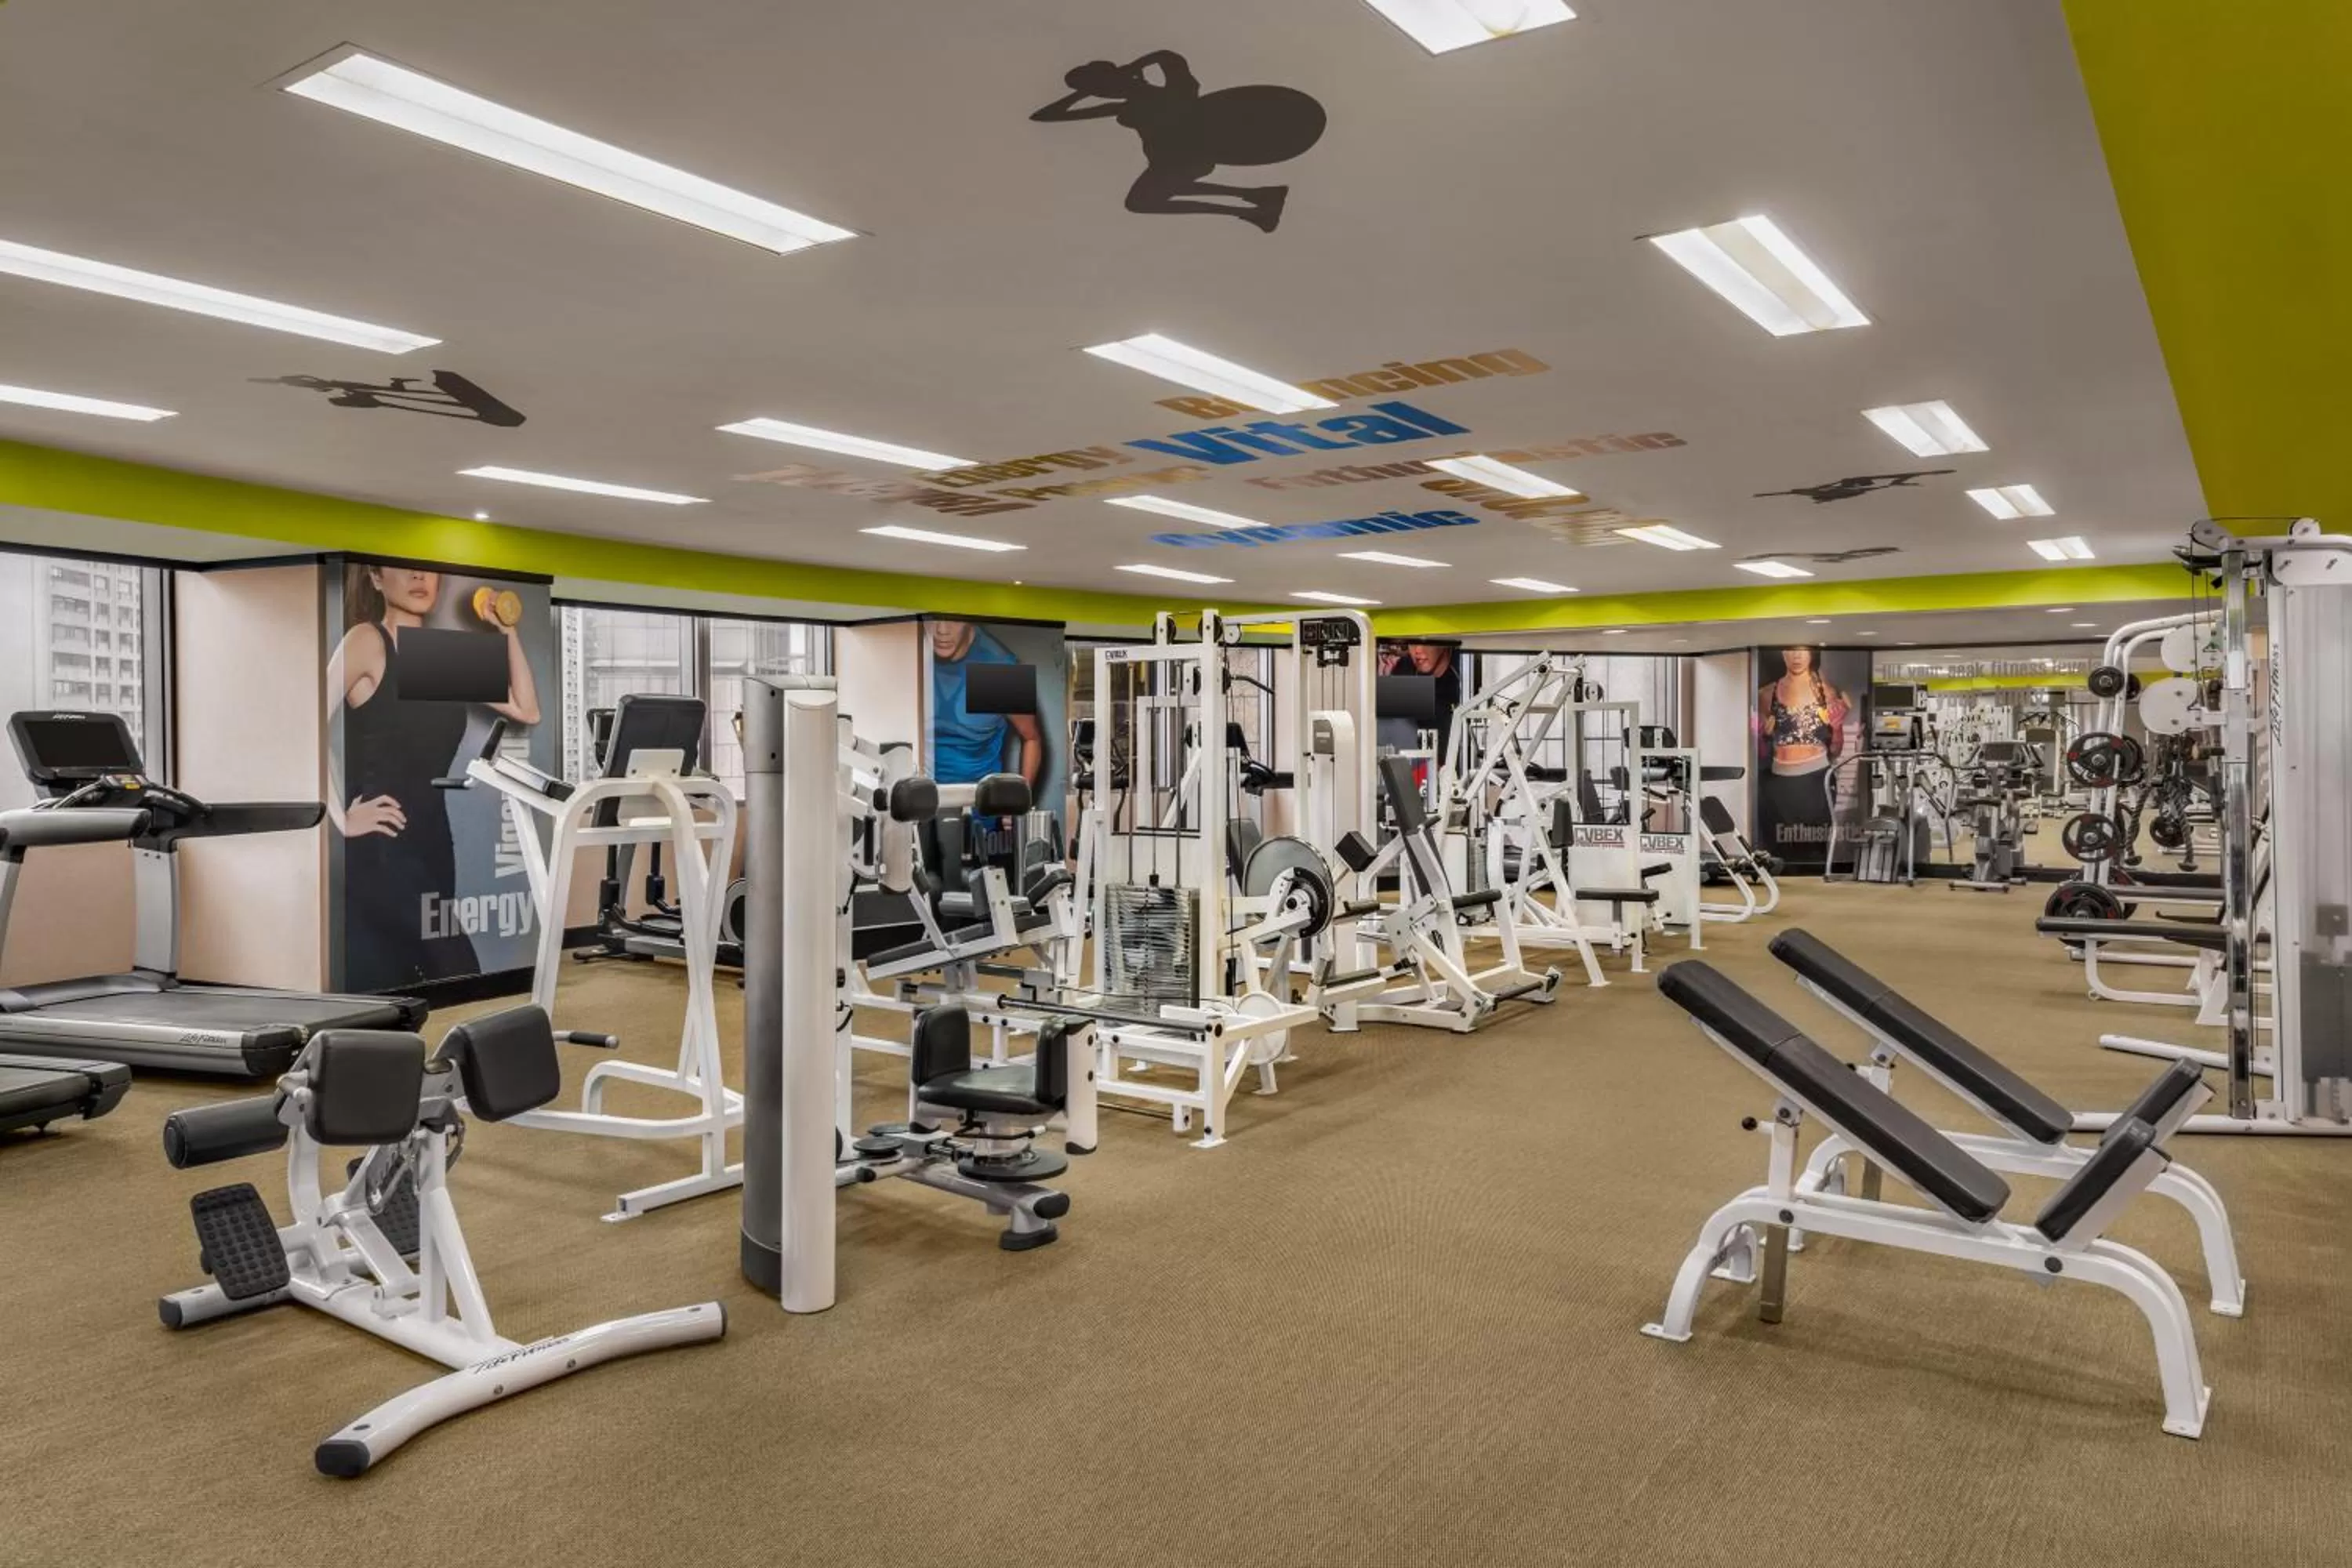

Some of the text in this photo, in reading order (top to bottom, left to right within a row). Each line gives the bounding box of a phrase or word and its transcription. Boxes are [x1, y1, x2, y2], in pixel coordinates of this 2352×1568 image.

[1154, 348, 1551, 419] Bncing
[1121, 401, 1472, 465] Vital
[1243, 432, 1688, 491] Enthuastic
[1991, 659, 2045, 677] fitness
[1574, 827, 1624, 842] CYBEX
[1639, 835, 1684, 849] CYBEX
[420, 891, 535, 941] Energy
